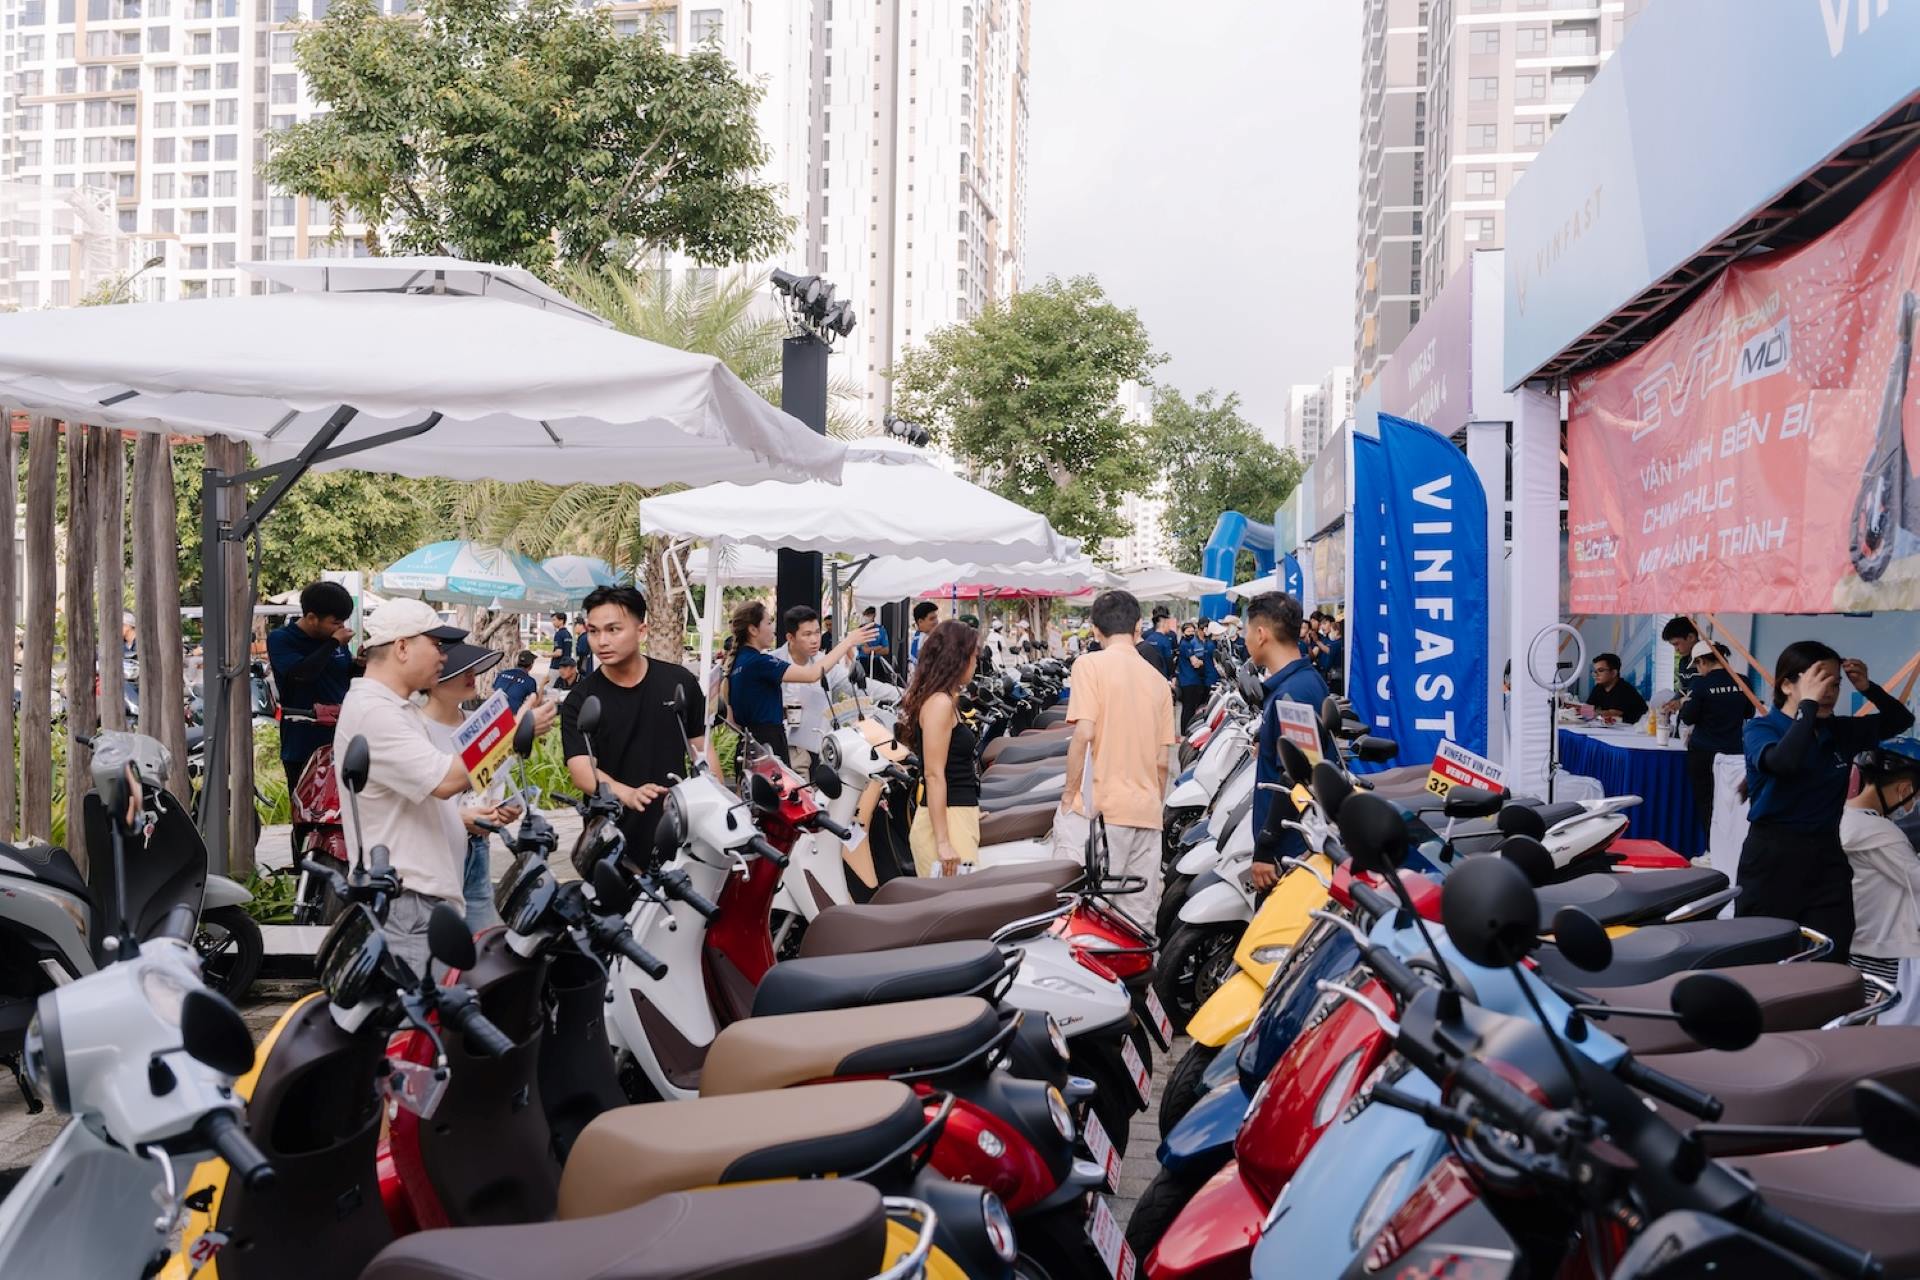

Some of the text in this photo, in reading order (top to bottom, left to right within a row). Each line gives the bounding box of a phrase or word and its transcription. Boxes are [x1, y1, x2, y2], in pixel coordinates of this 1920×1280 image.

[1818, 0, 1889, 57] VI
[1536, 184, 1604, 277] VINFAST
[1412, 474, 1456, 742] VINFAST
[476, 767, 492, 788] 12
[1443, 745, 1472, 767] VINFAST
[1472, 759, 1485, 774] VIN
[1485, 765, 1502, 781] CITY
[1428, 777, 1449, 797] 32
